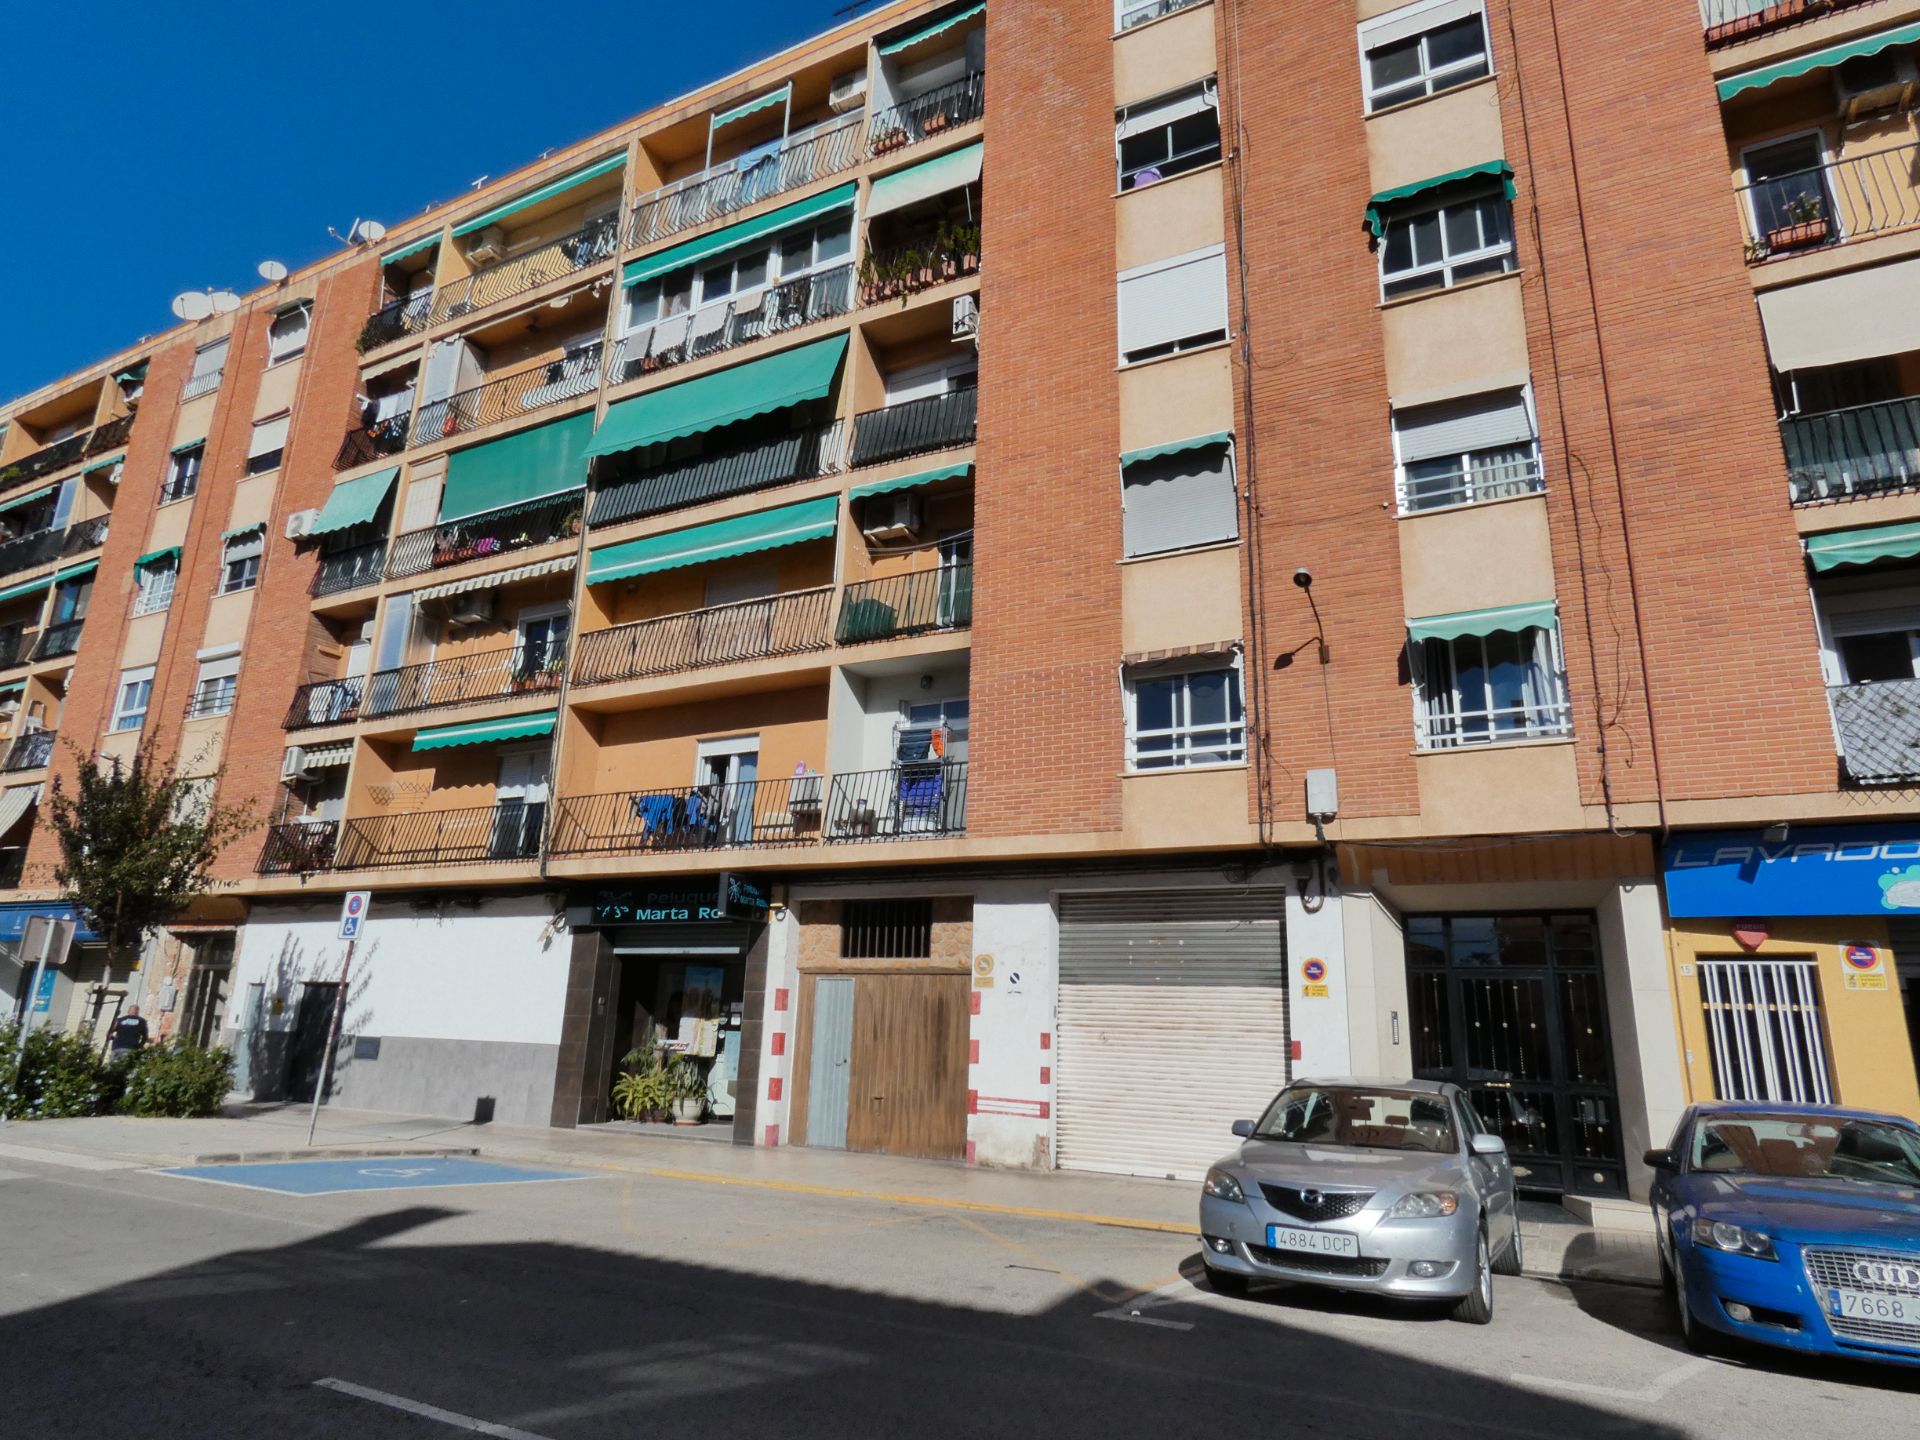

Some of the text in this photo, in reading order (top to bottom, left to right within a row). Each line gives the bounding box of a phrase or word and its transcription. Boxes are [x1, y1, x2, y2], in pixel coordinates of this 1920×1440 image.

[636, 907, 689, 921] Marta
[1280, 1231, 1352, 1252] 4884 DCP
[1846, 1295, 1904, 1319] 7668
